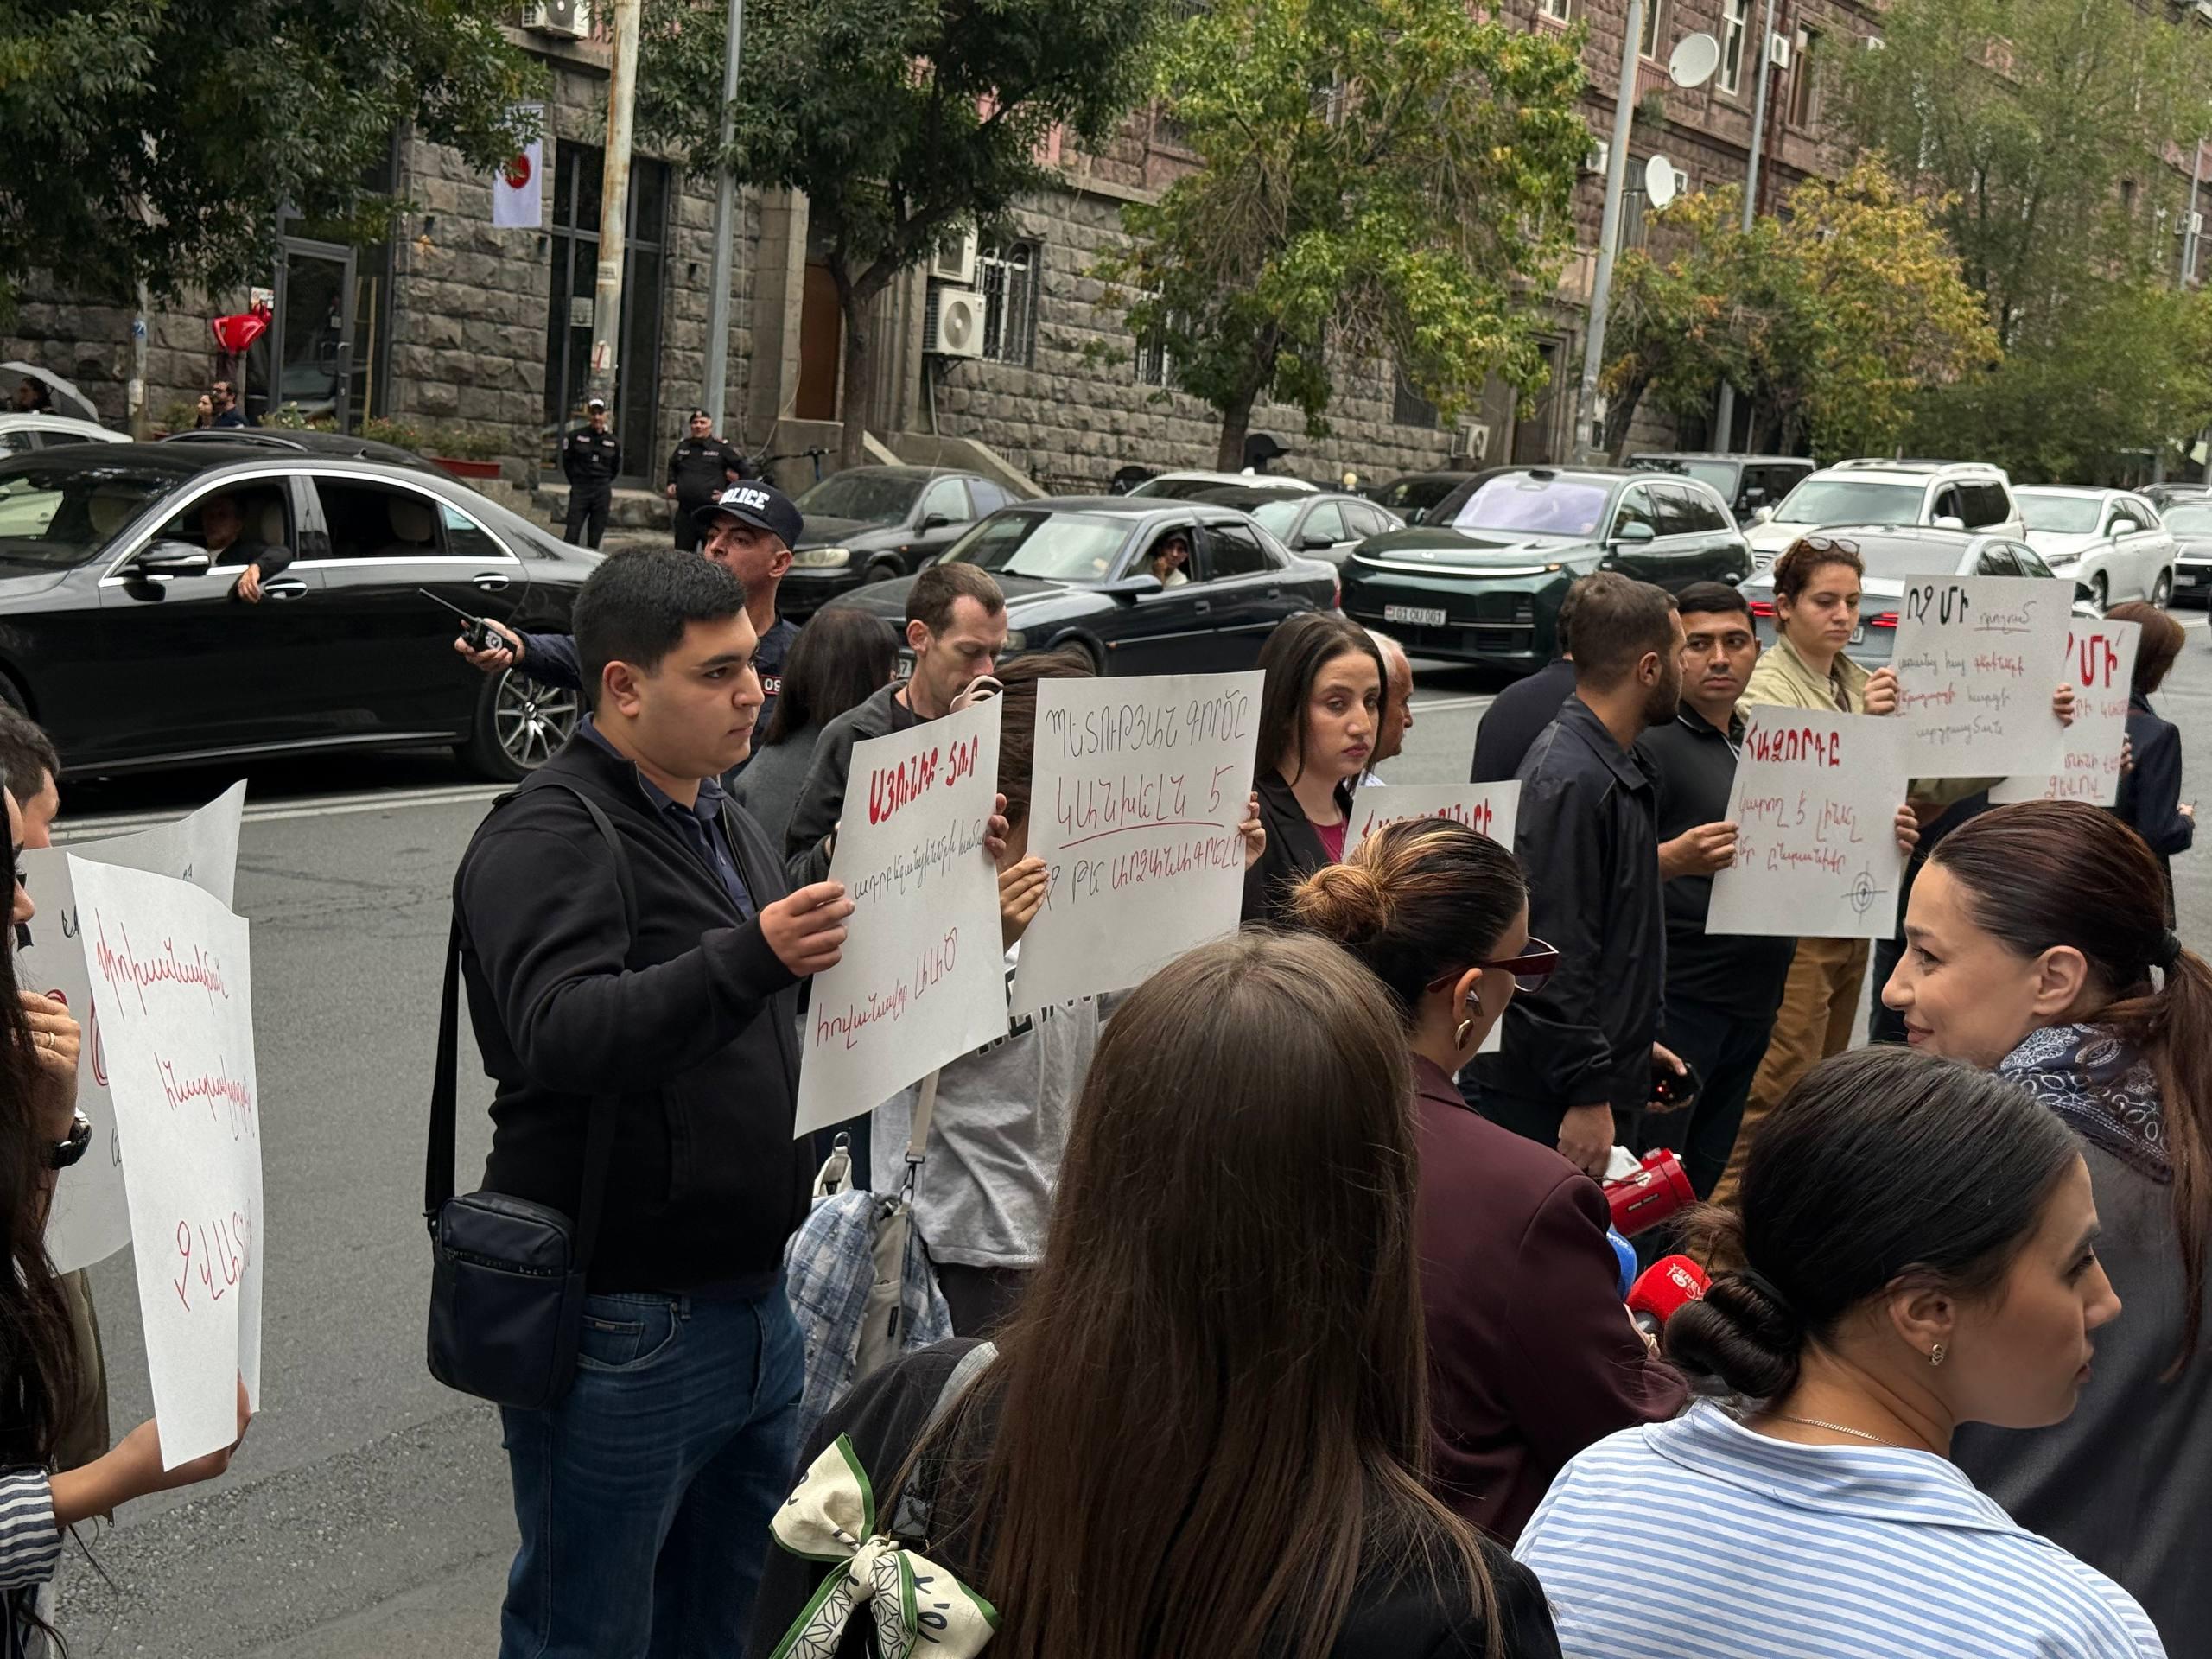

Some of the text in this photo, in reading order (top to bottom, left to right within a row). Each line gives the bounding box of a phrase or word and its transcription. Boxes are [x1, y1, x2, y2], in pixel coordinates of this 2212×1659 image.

[1907, 585, 1934, 626] ՈՉ
[1939, 586, 1969, 626] ՄԻ
[1045, 690, 1249, 759] ՊԵՏՈՒԹՅԱՆ ԳՈՐԾԸ
